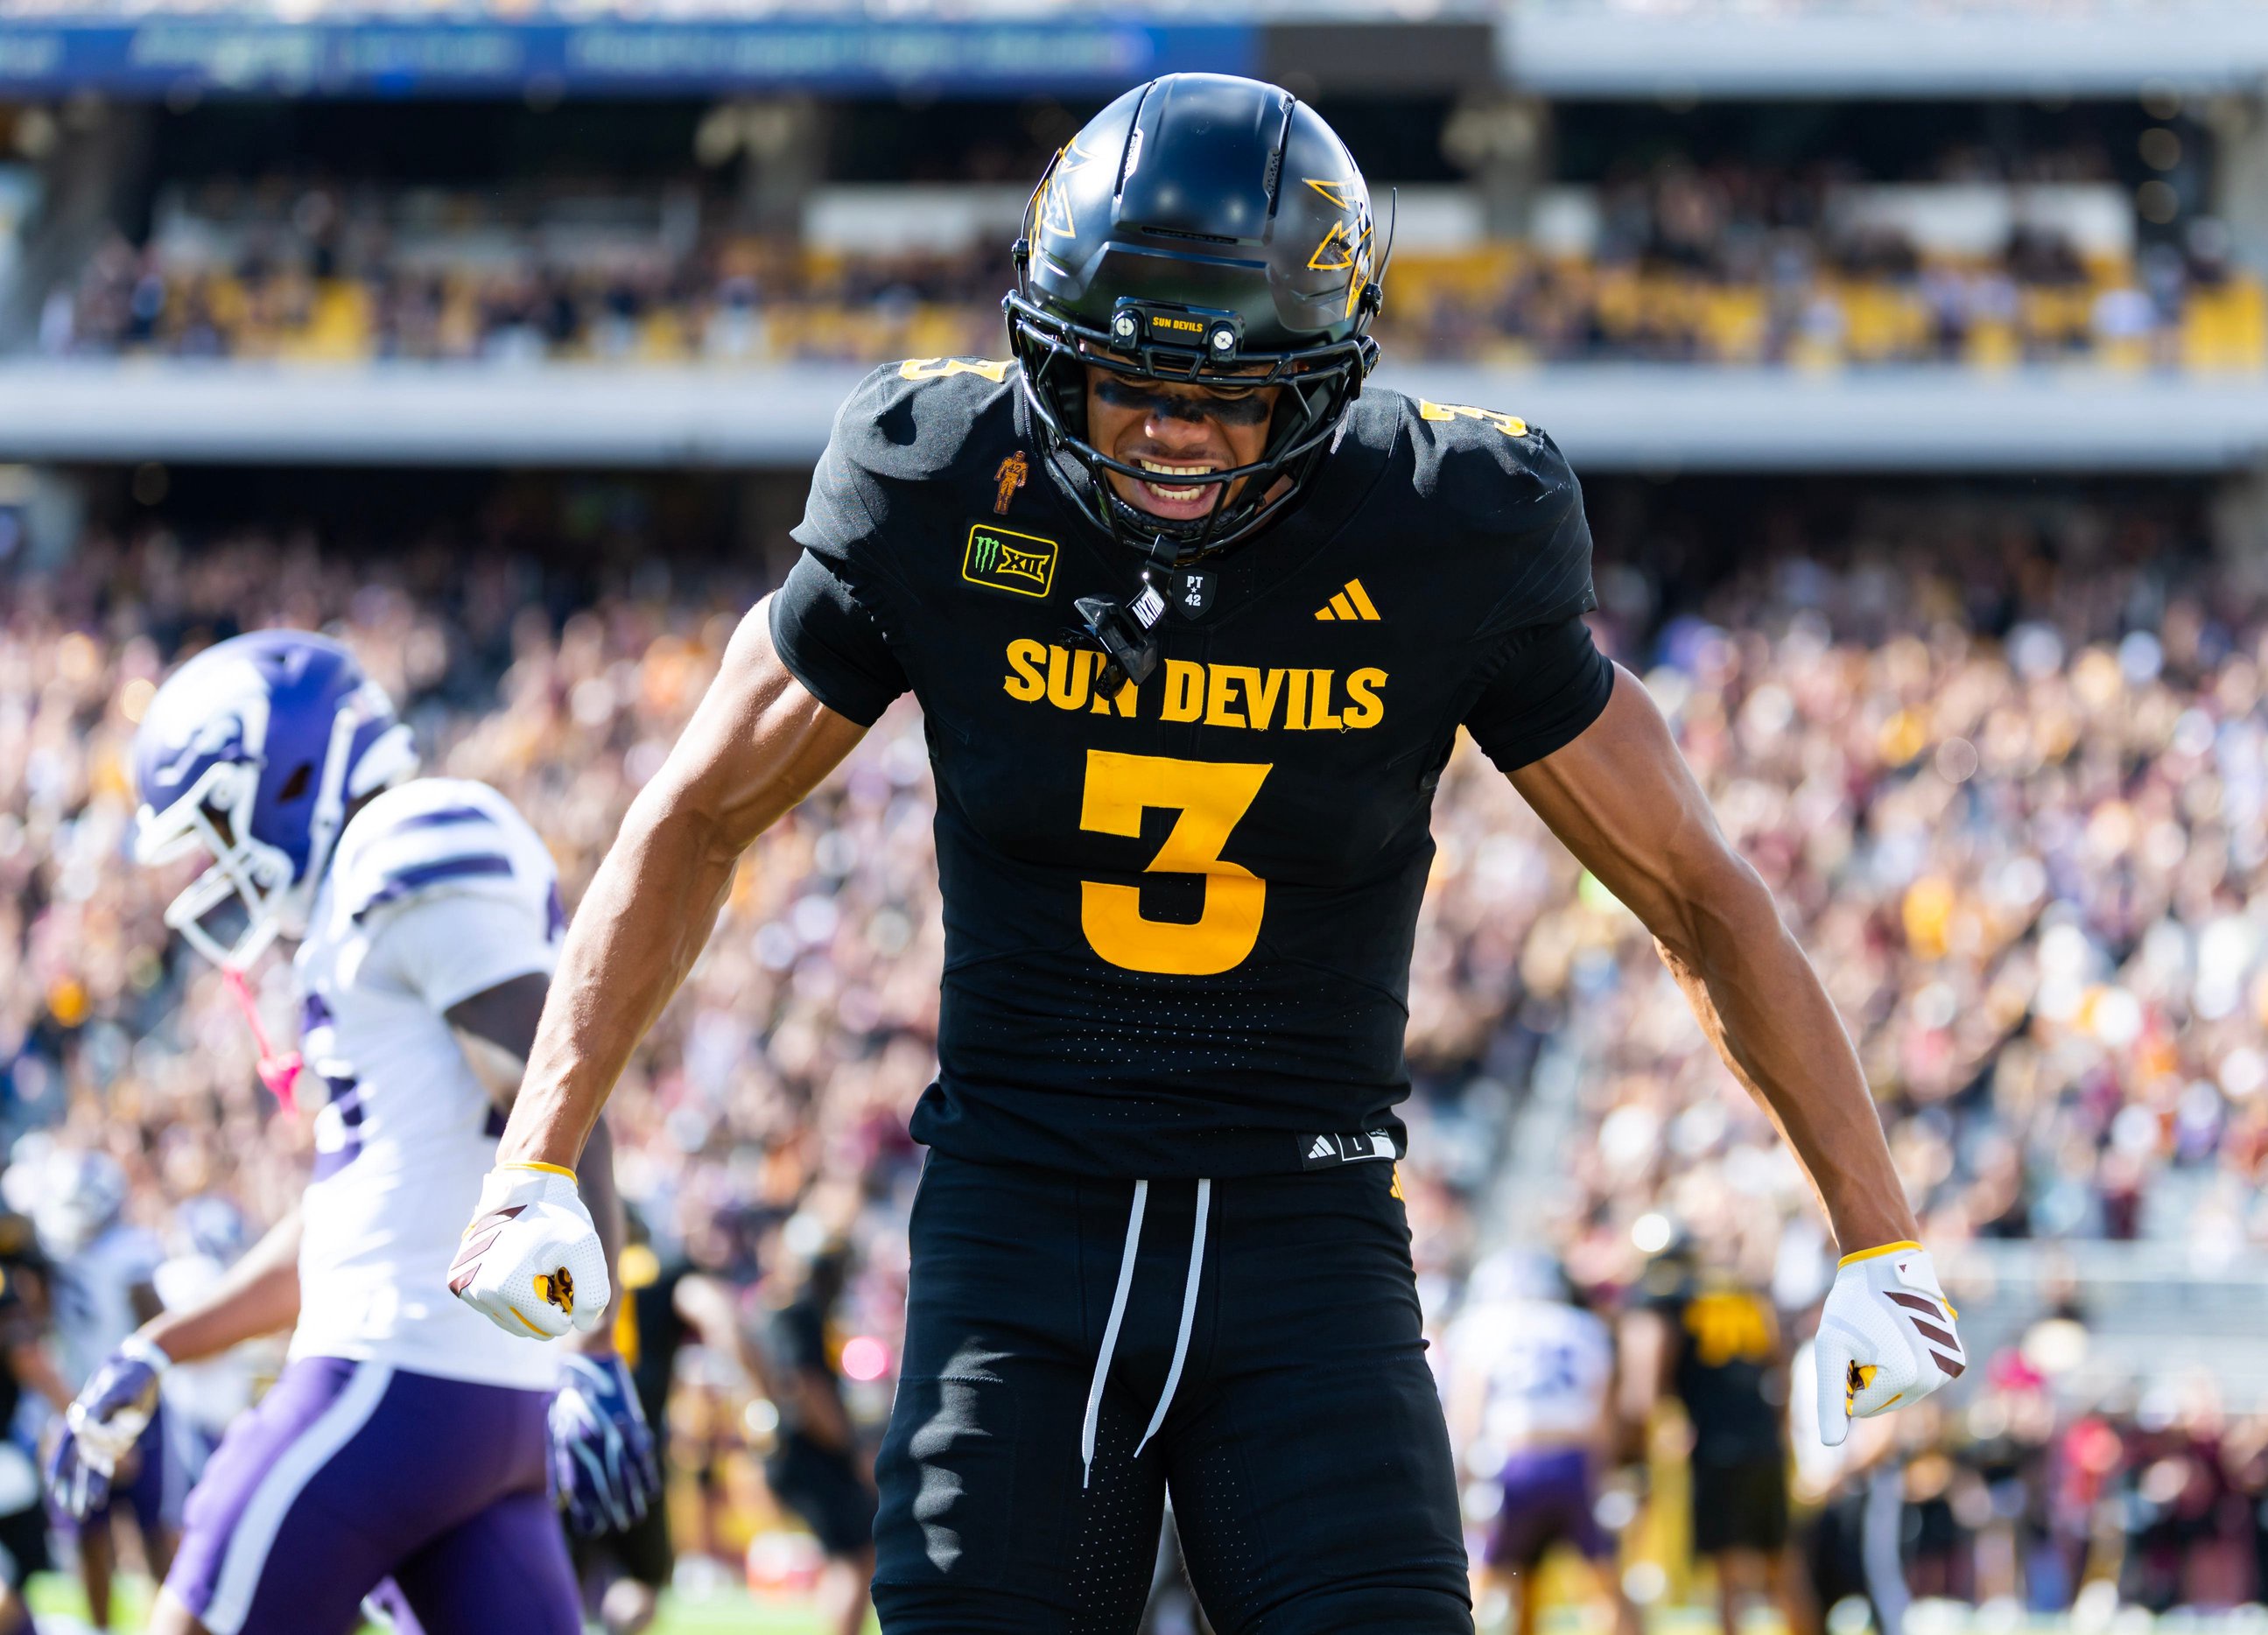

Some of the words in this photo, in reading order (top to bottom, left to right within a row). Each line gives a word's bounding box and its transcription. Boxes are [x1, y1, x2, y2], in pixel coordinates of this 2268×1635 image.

[1153, 316, 1171, 328] SUN
[1173, 319, 1203, 333] DEVILS
[1008, 463, 1022, 475] 42
[1186, 575, 1204, 589] PT
[1184, 593, 1202, 607] 42
[1003, 638, 1138, 718] SUN
[1160, 658, 1389, 731] DEVILS
[1079, 749, 1274, 976] 3
